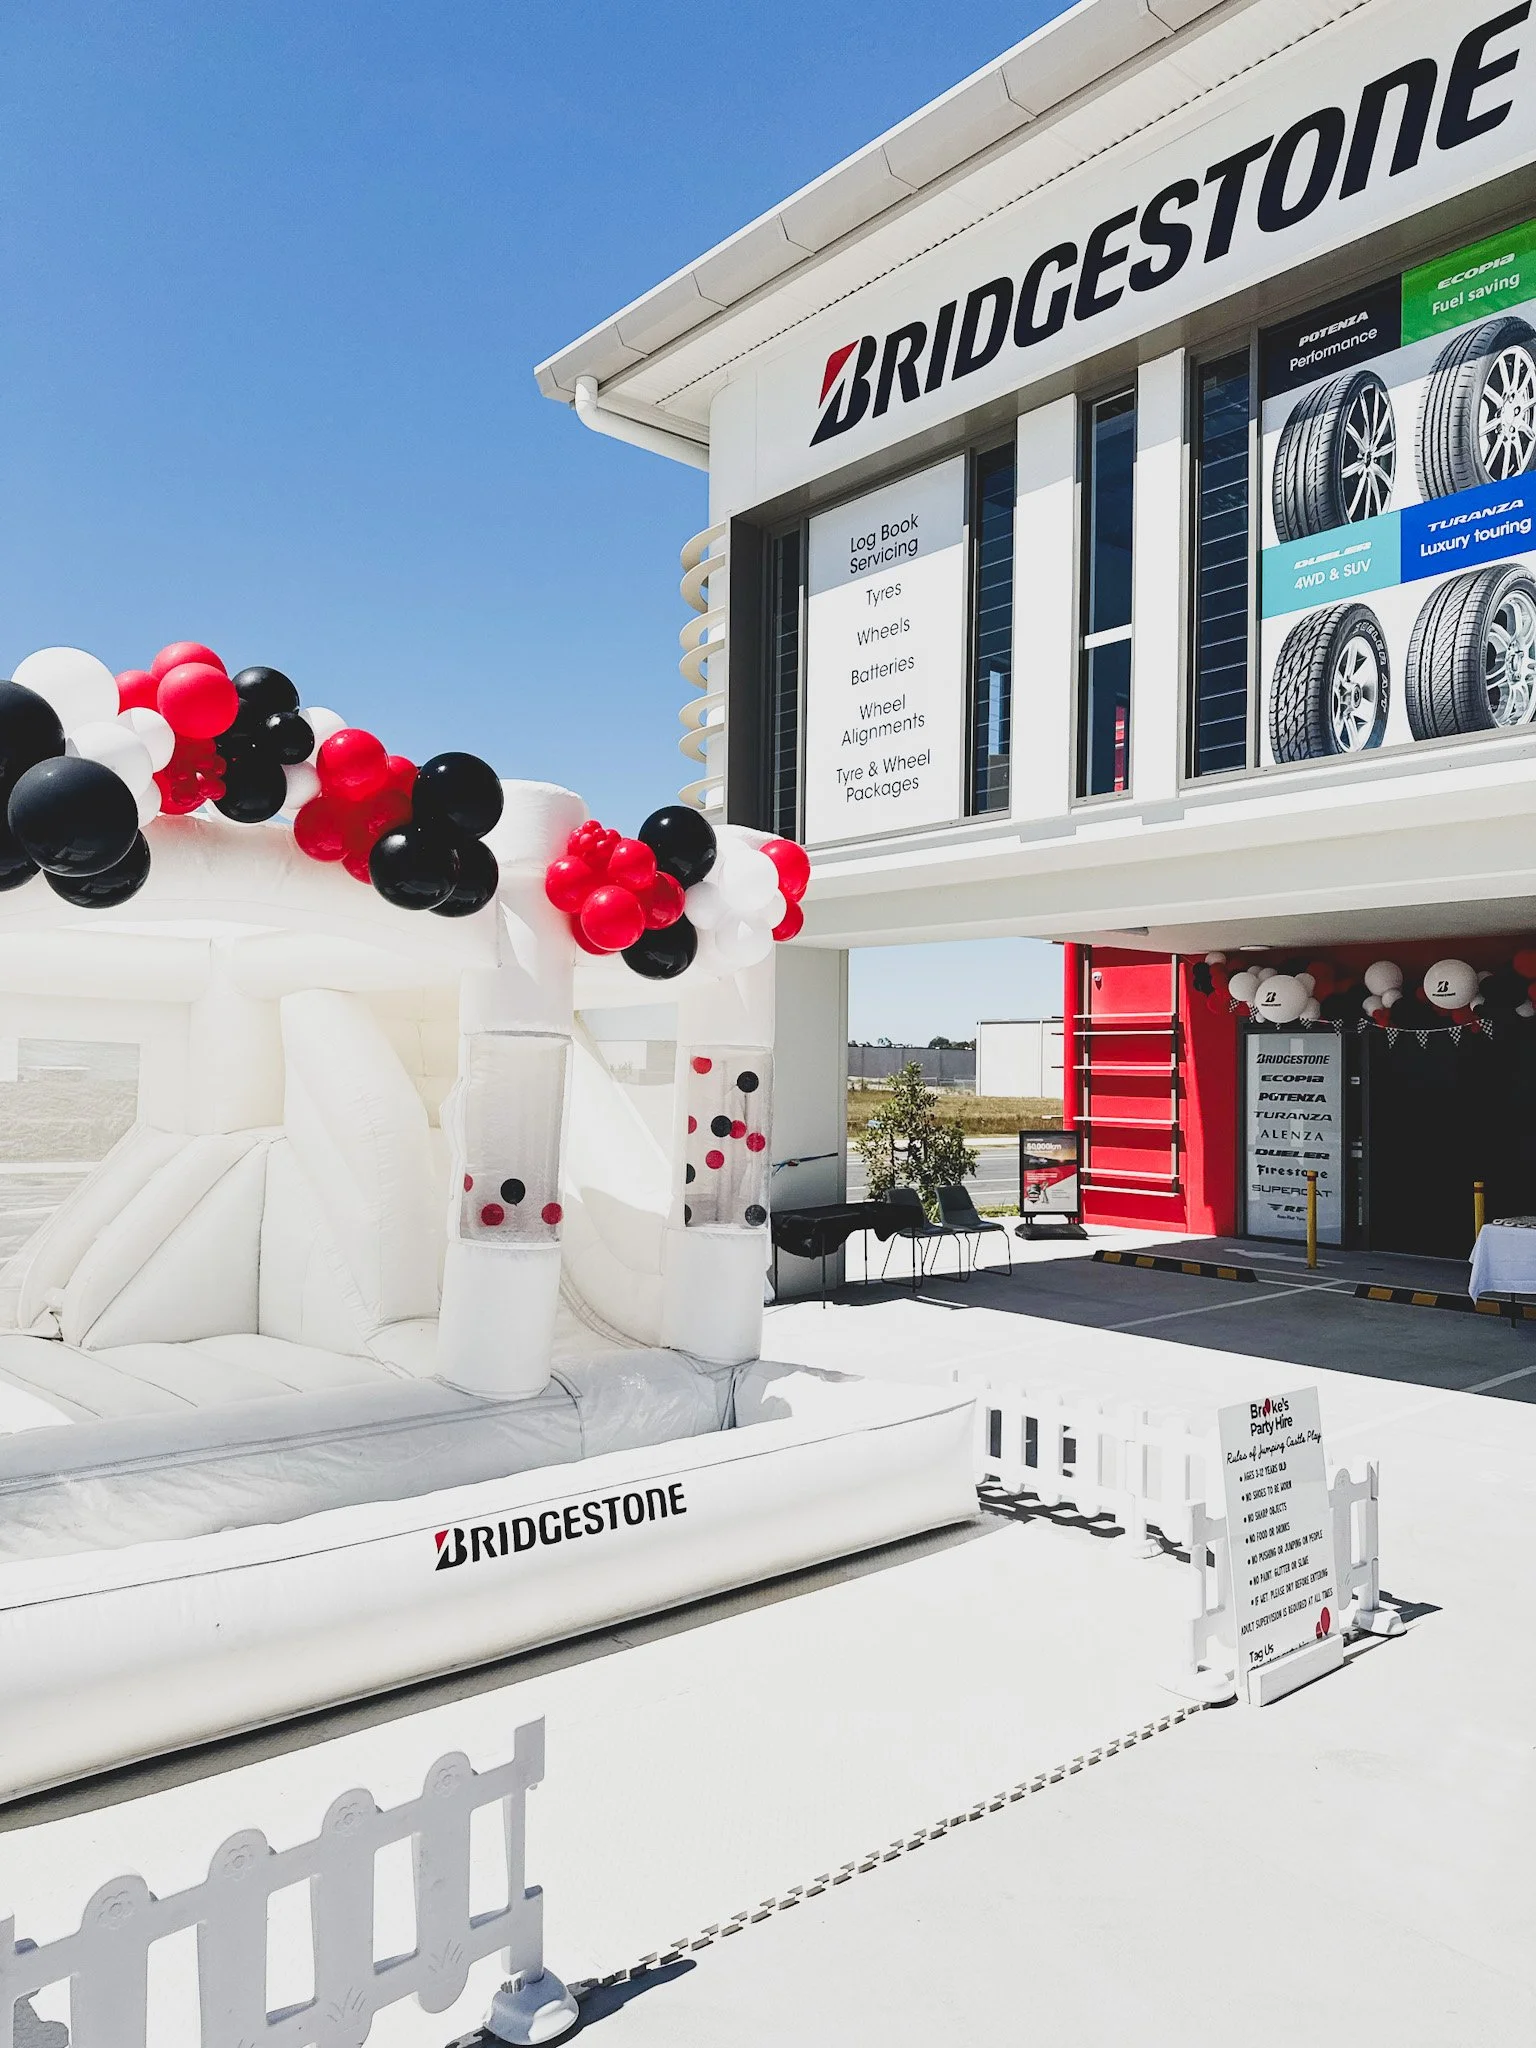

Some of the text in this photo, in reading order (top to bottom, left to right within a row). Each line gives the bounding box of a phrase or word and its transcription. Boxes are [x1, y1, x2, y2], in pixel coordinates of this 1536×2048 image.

[809, 3, 1532, 447] BRIDGESTONE
[1432, 273, 1520, 316] Fuel saving
[1298, 311, 1369, 347] POTENZA
[1289, 327, 1378, 371] Performance
[1427, 500, 1524, 533] TURANZA
[850, 513, 919, 553] Log Book
[1420, 517, 1532, 557] Luxury touring
[850, 537, 918, 574] Servicing
[1294, 558, 1372, 590] 4WD & SUV
[866, 582, 902, 607] Tyres
[857, 617, 910, 646] Wheels
[851, 655, 915, 686] Batteries
[859, 694, 906, 720] Wheel
[841, 712, 925, 746] Alignments
[836, 749, 930, 786] Tyre & Wheel
[846, 776, 919, 802] Packages
[1256, 1053, 1330, 1065] BRIDGESTONE
[1261, 1074, 1325, 1083] ECOPIA
[1258, 1092, 1327, 1103] POTENZA
[1253, 1111, 1333, 1121] TURANZA
[1260, 1129, 1324, 1141] ALENZA
[1255, 1148, 1330, 1160] DUELER
[1250, 1414, 1293, 1437] Party Hire
[1227, 1430, 1322, 1465] Rules of Jumping Castle Play
[1244, 1470, 1255, 1481] AGES
[1265, 1463, 1278, 1475] YEARS
[1245, 1492, 1252, 1502] NO
[1253, 1487, 1267, 1500] SHOES
[1267, 1485, 1273, 1495] TO
[1274, 1483, 1280, 1494] BE
[1247, 1502, 1287, 1523] NO SHARP OBJECTS
[434, 1483, 687, 1571] BRIDGESTONE
[1249, 1533, 1256, 1543] NO
[1256, 1529, 1268, 1541] FOOD
[1269, 1527, 1275, 1537] OR
[1251, 1554, 1258, 1564] NO
[1277, 1545, 1283, 1555] OR
[1253, 1575, 1259, 1585] NO
[1270, 1585, 1285, 1599] PLEASE
[1255, 1610, 1282, 1629] SUPERVISION
[1249, 1650, 1263, 1663] Tag
[1265, 1643, 1274, 1656] Us
